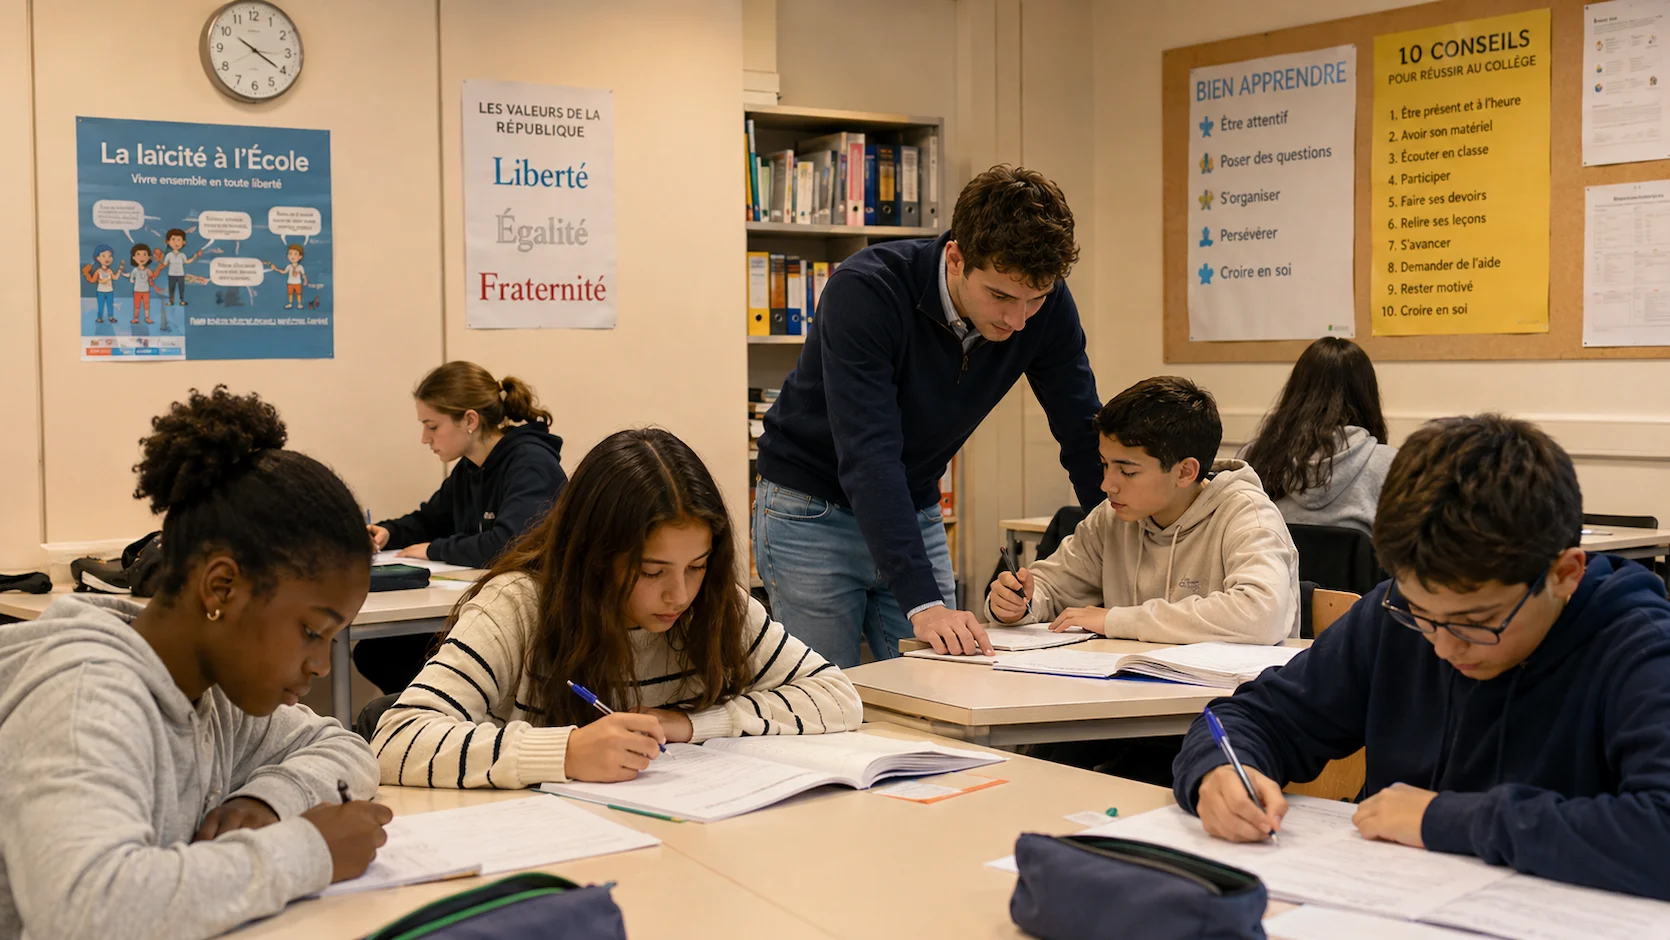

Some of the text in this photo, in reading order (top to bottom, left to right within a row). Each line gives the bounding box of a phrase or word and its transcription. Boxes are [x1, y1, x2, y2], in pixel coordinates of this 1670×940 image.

[234, 14, 241, 24] 11
[249, 11, 259, 21] 12
[268, 17, 272, 27] 1
[221, 26, 231, 36] 10
[279, 30, 286, 40] 2
[216, 43, 223, 52] 9
[285, 48, 291, 58] 3
[1399, 29, 1530, 65] 10 CONSEILS
[222, 61, 229, 71] 8
[280, 66, 286, 75] 4
[1388, 55, 1536, 85] POUR RÉUSSIR AU COLLÈGE
[236, 74, 242, 85] 7
[252, 80, 258, 90] 6
[268, 77, 275, 86] 5
[1196, 60, 1347, 102] BIEN APPRENDRE
[479, 102, 600, 121] LES VALEURS DE LA
[1390, 110, 1398, 120] 1.
[1424, 102, 1461, 119] présent
[1464, 101, 1474, 111] et
[1476, 99, 1482, 110] à
[1485, 96, 1521, 109] l'heure
[1246, 110, 1289, 128] attentif
[496, 120, 585, 138] RÉPUBLIQUE
[1388, 119, 1493, 142] 2. Avoir son matériel
[101, 142, 310, 172] La laïcité à l'École
[1221, 146, 1332, 168] Poser des questions
[1388, 144, 1489, 164] 3. Écouter en classe
[492, 156, 589, 189] Liberté
[1388, 171, 1450, 187] 4. Participer
[131, 173, 282, 189] Vivre ensemble en toute liberté
[1221, 189, 1280, 208] S'organiser
[1388, 190, 1487, 207] 5. Faire ses devoirs
[1388, 213, 1486, 229] 6. Relire ses leçons
[495, 208, 588, 253] Égalité
[1220, 227, 1278, 242] Persévérer
[1388, 238, 1451, 251] 7. S'avancer
[1220, 263, 1292, 279] Croire en soi
[1388, 257, 1501, 273] 8. Demander de l'aide
[478, 272, 606, 301] Fraternité
[1388, 281, 1473, 295] 9. Rester motivé
[1382, 304, 1467, 317] 10. Croire en soi
